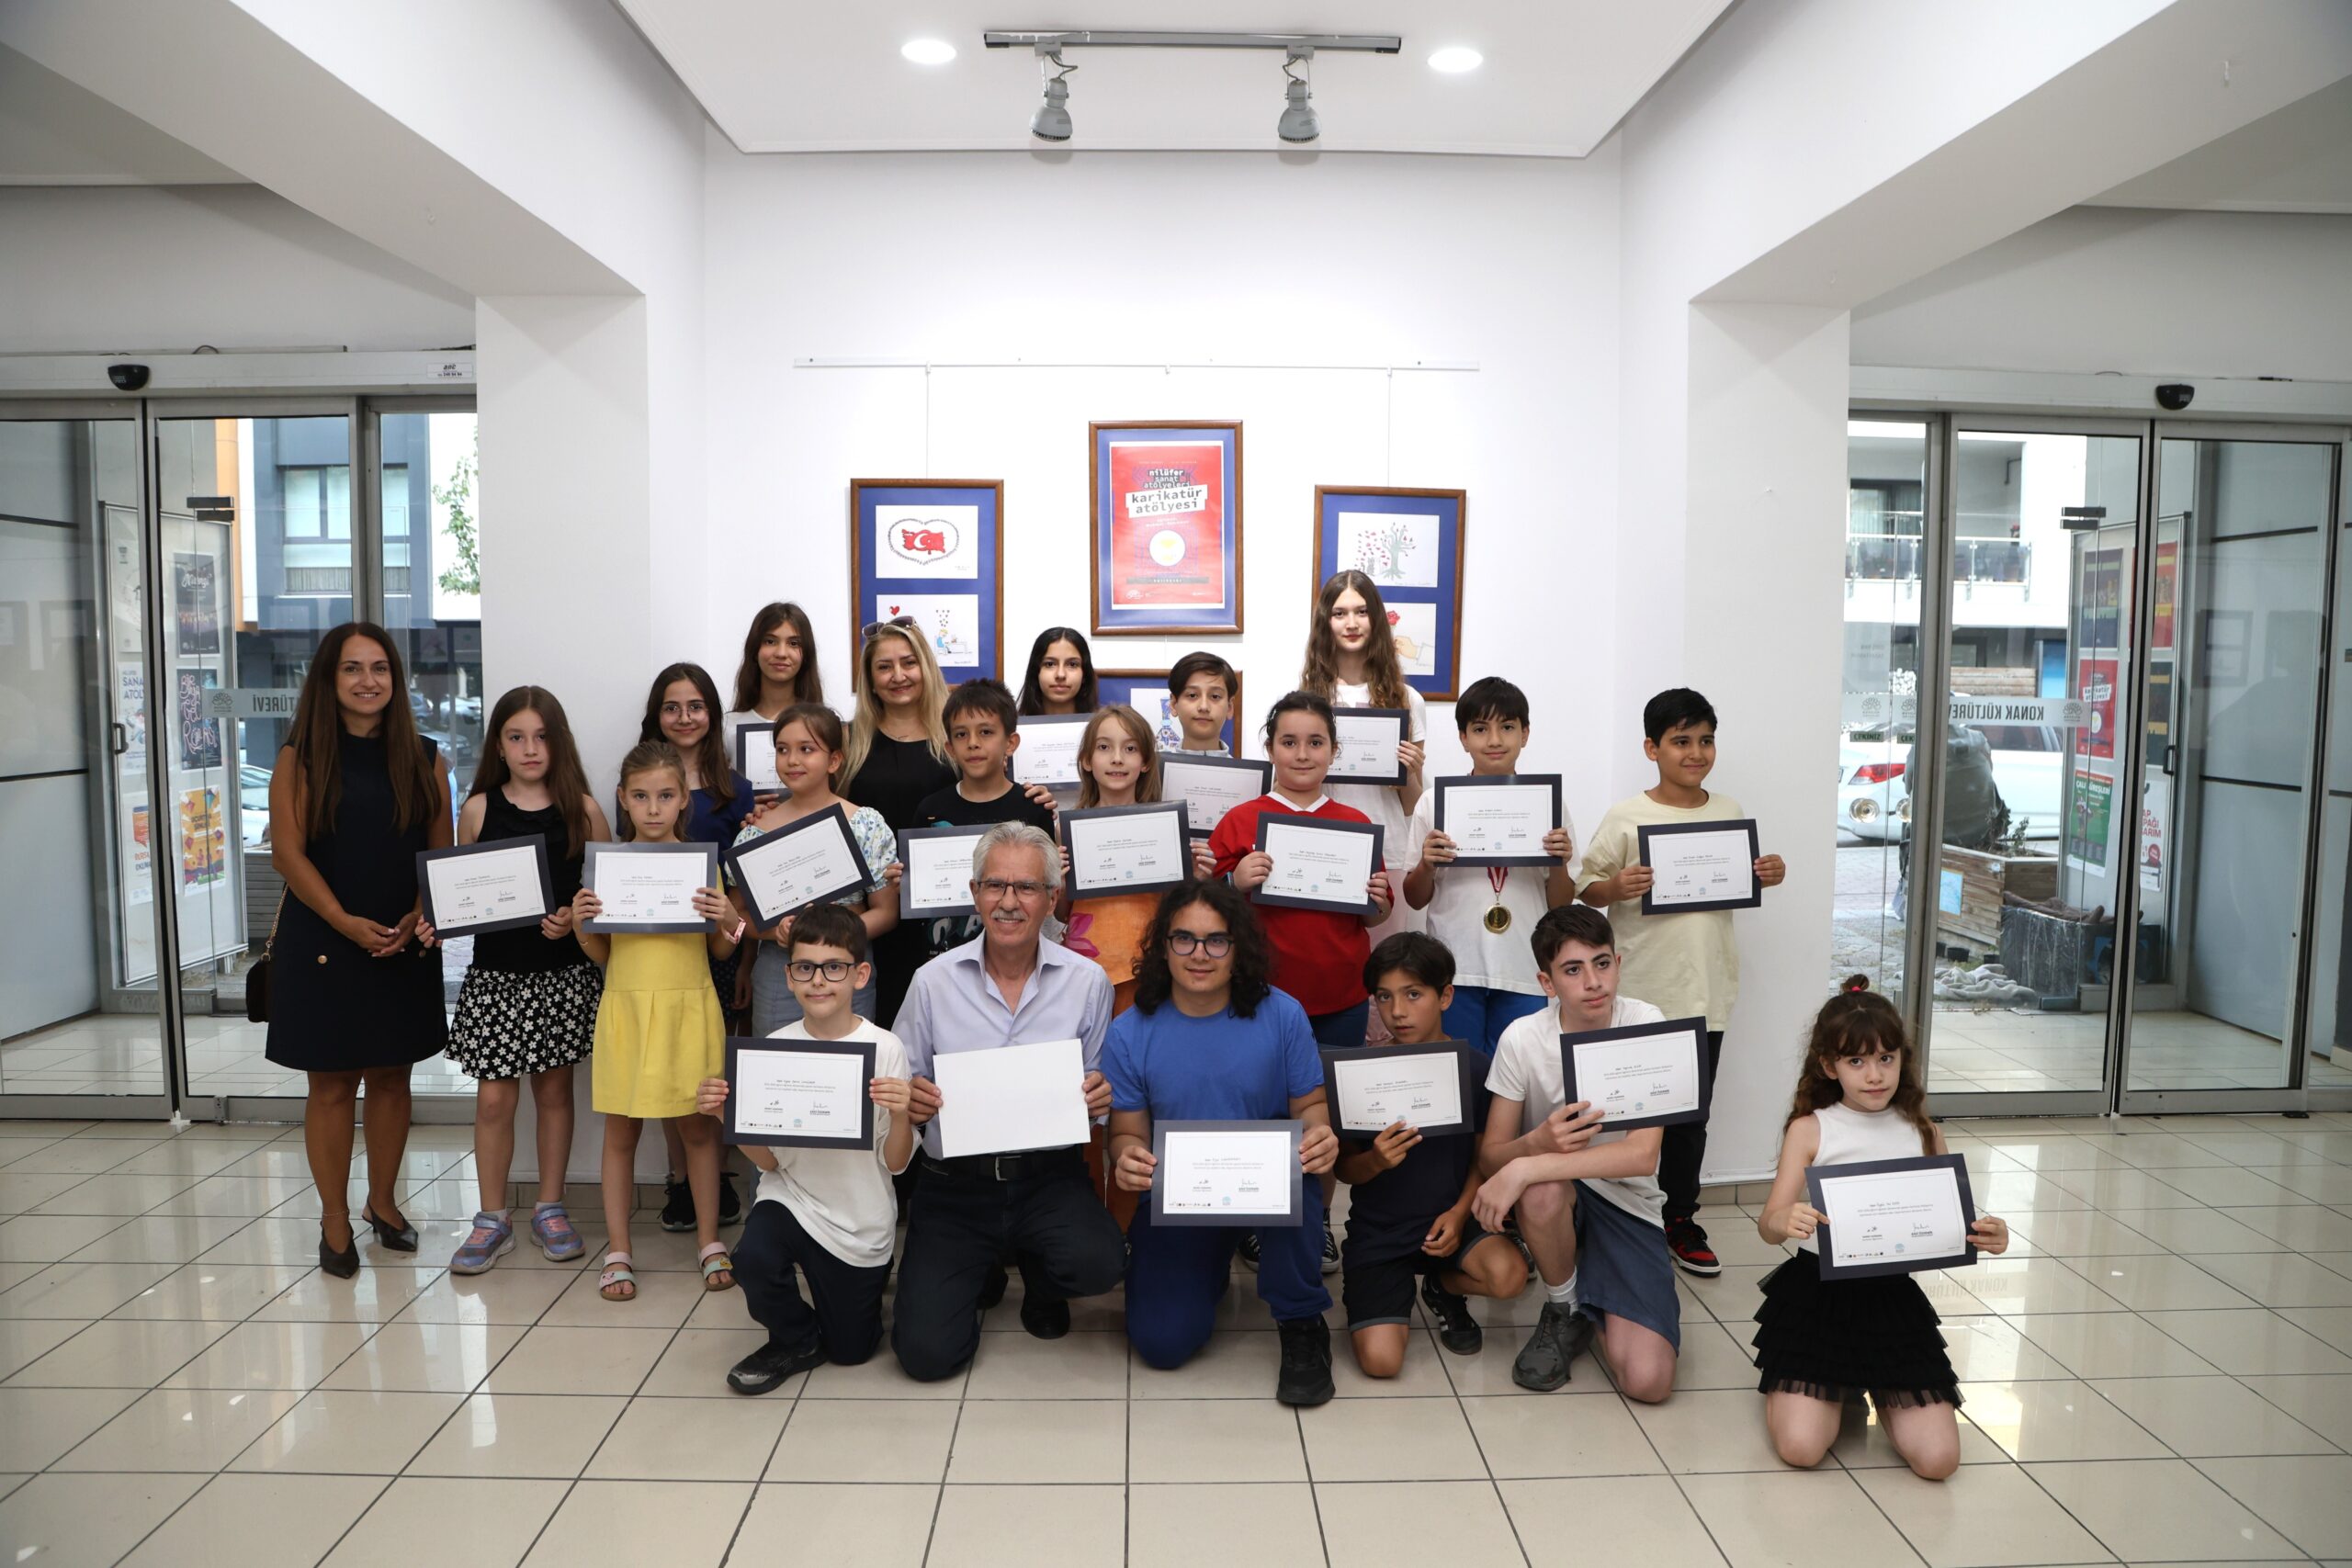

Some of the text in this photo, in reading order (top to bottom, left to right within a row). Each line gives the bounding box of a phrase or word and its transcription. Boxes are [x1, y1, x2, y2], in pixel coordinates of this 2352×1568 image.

[1148, 468, 1184, 477] nilüfer
[1132, 487, 1203, 503] karikatür
[1136, 498, 1197, 514] atölyesi
[122, 676, 144, 687] SANA
[1853, 731, 1882, 741] ÇEKİNİZ
[2088, 782, 2111, 795] ÜREŞLERİ
